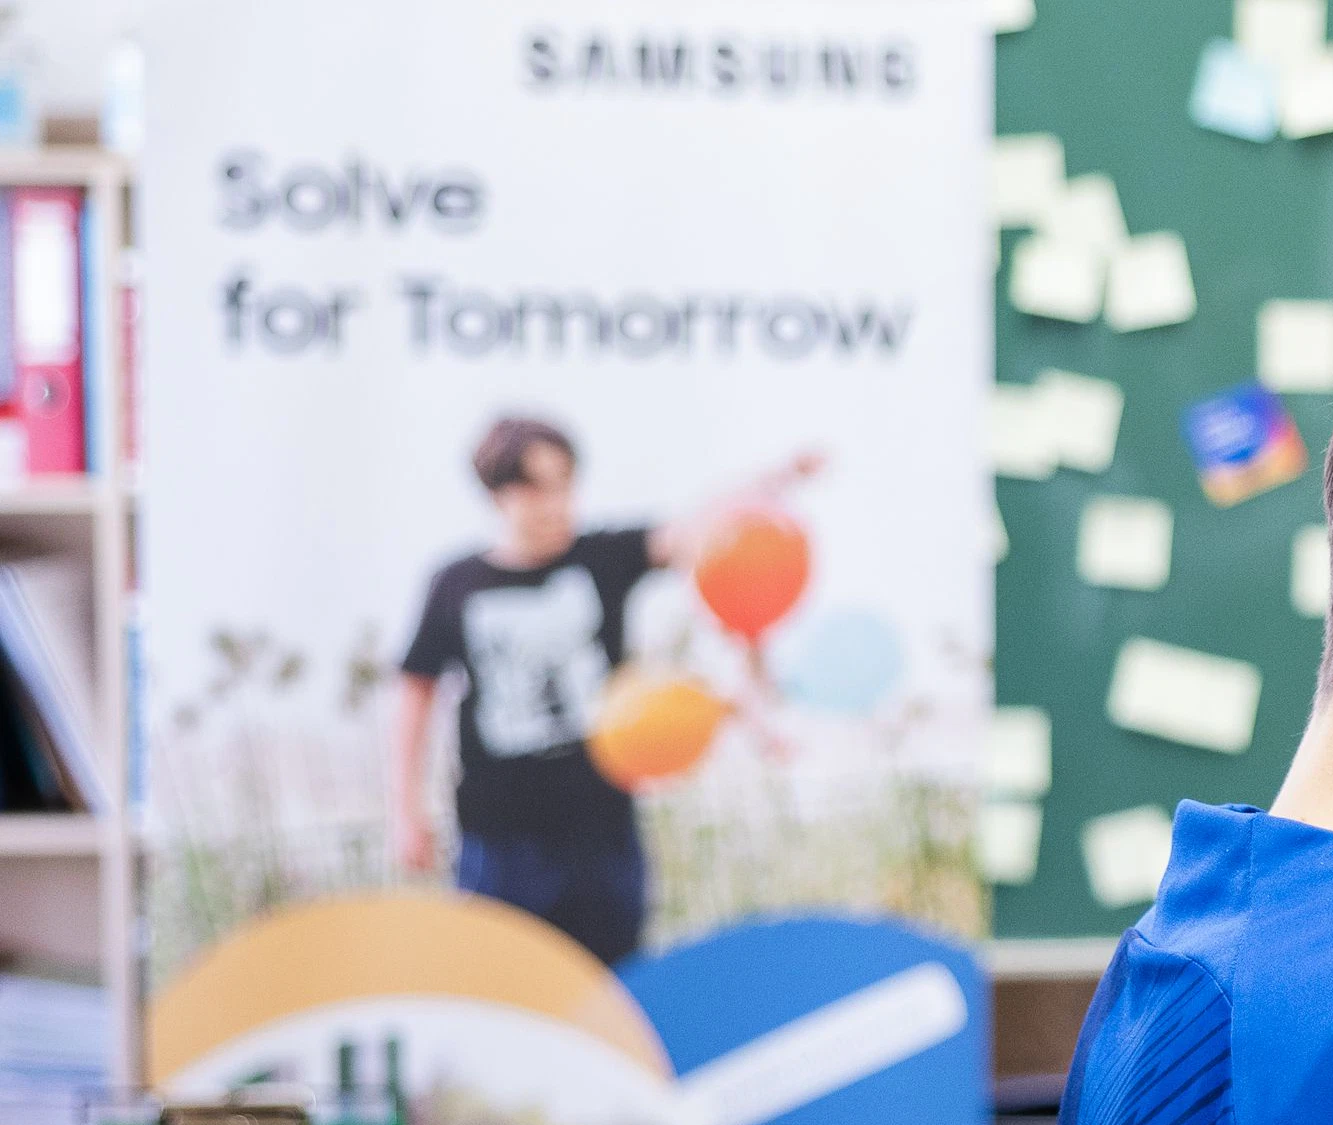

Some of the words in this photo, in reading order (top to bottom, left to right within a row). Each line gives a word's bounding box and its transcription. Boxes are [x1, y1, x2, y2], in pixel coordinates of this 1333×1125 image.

[524, 33, 918, 92] SAMSUNG
[220, 154, 488, 230] Solve
[222, 270, 354, 356] for
[402, 274, 914, 358] Tomorrow
